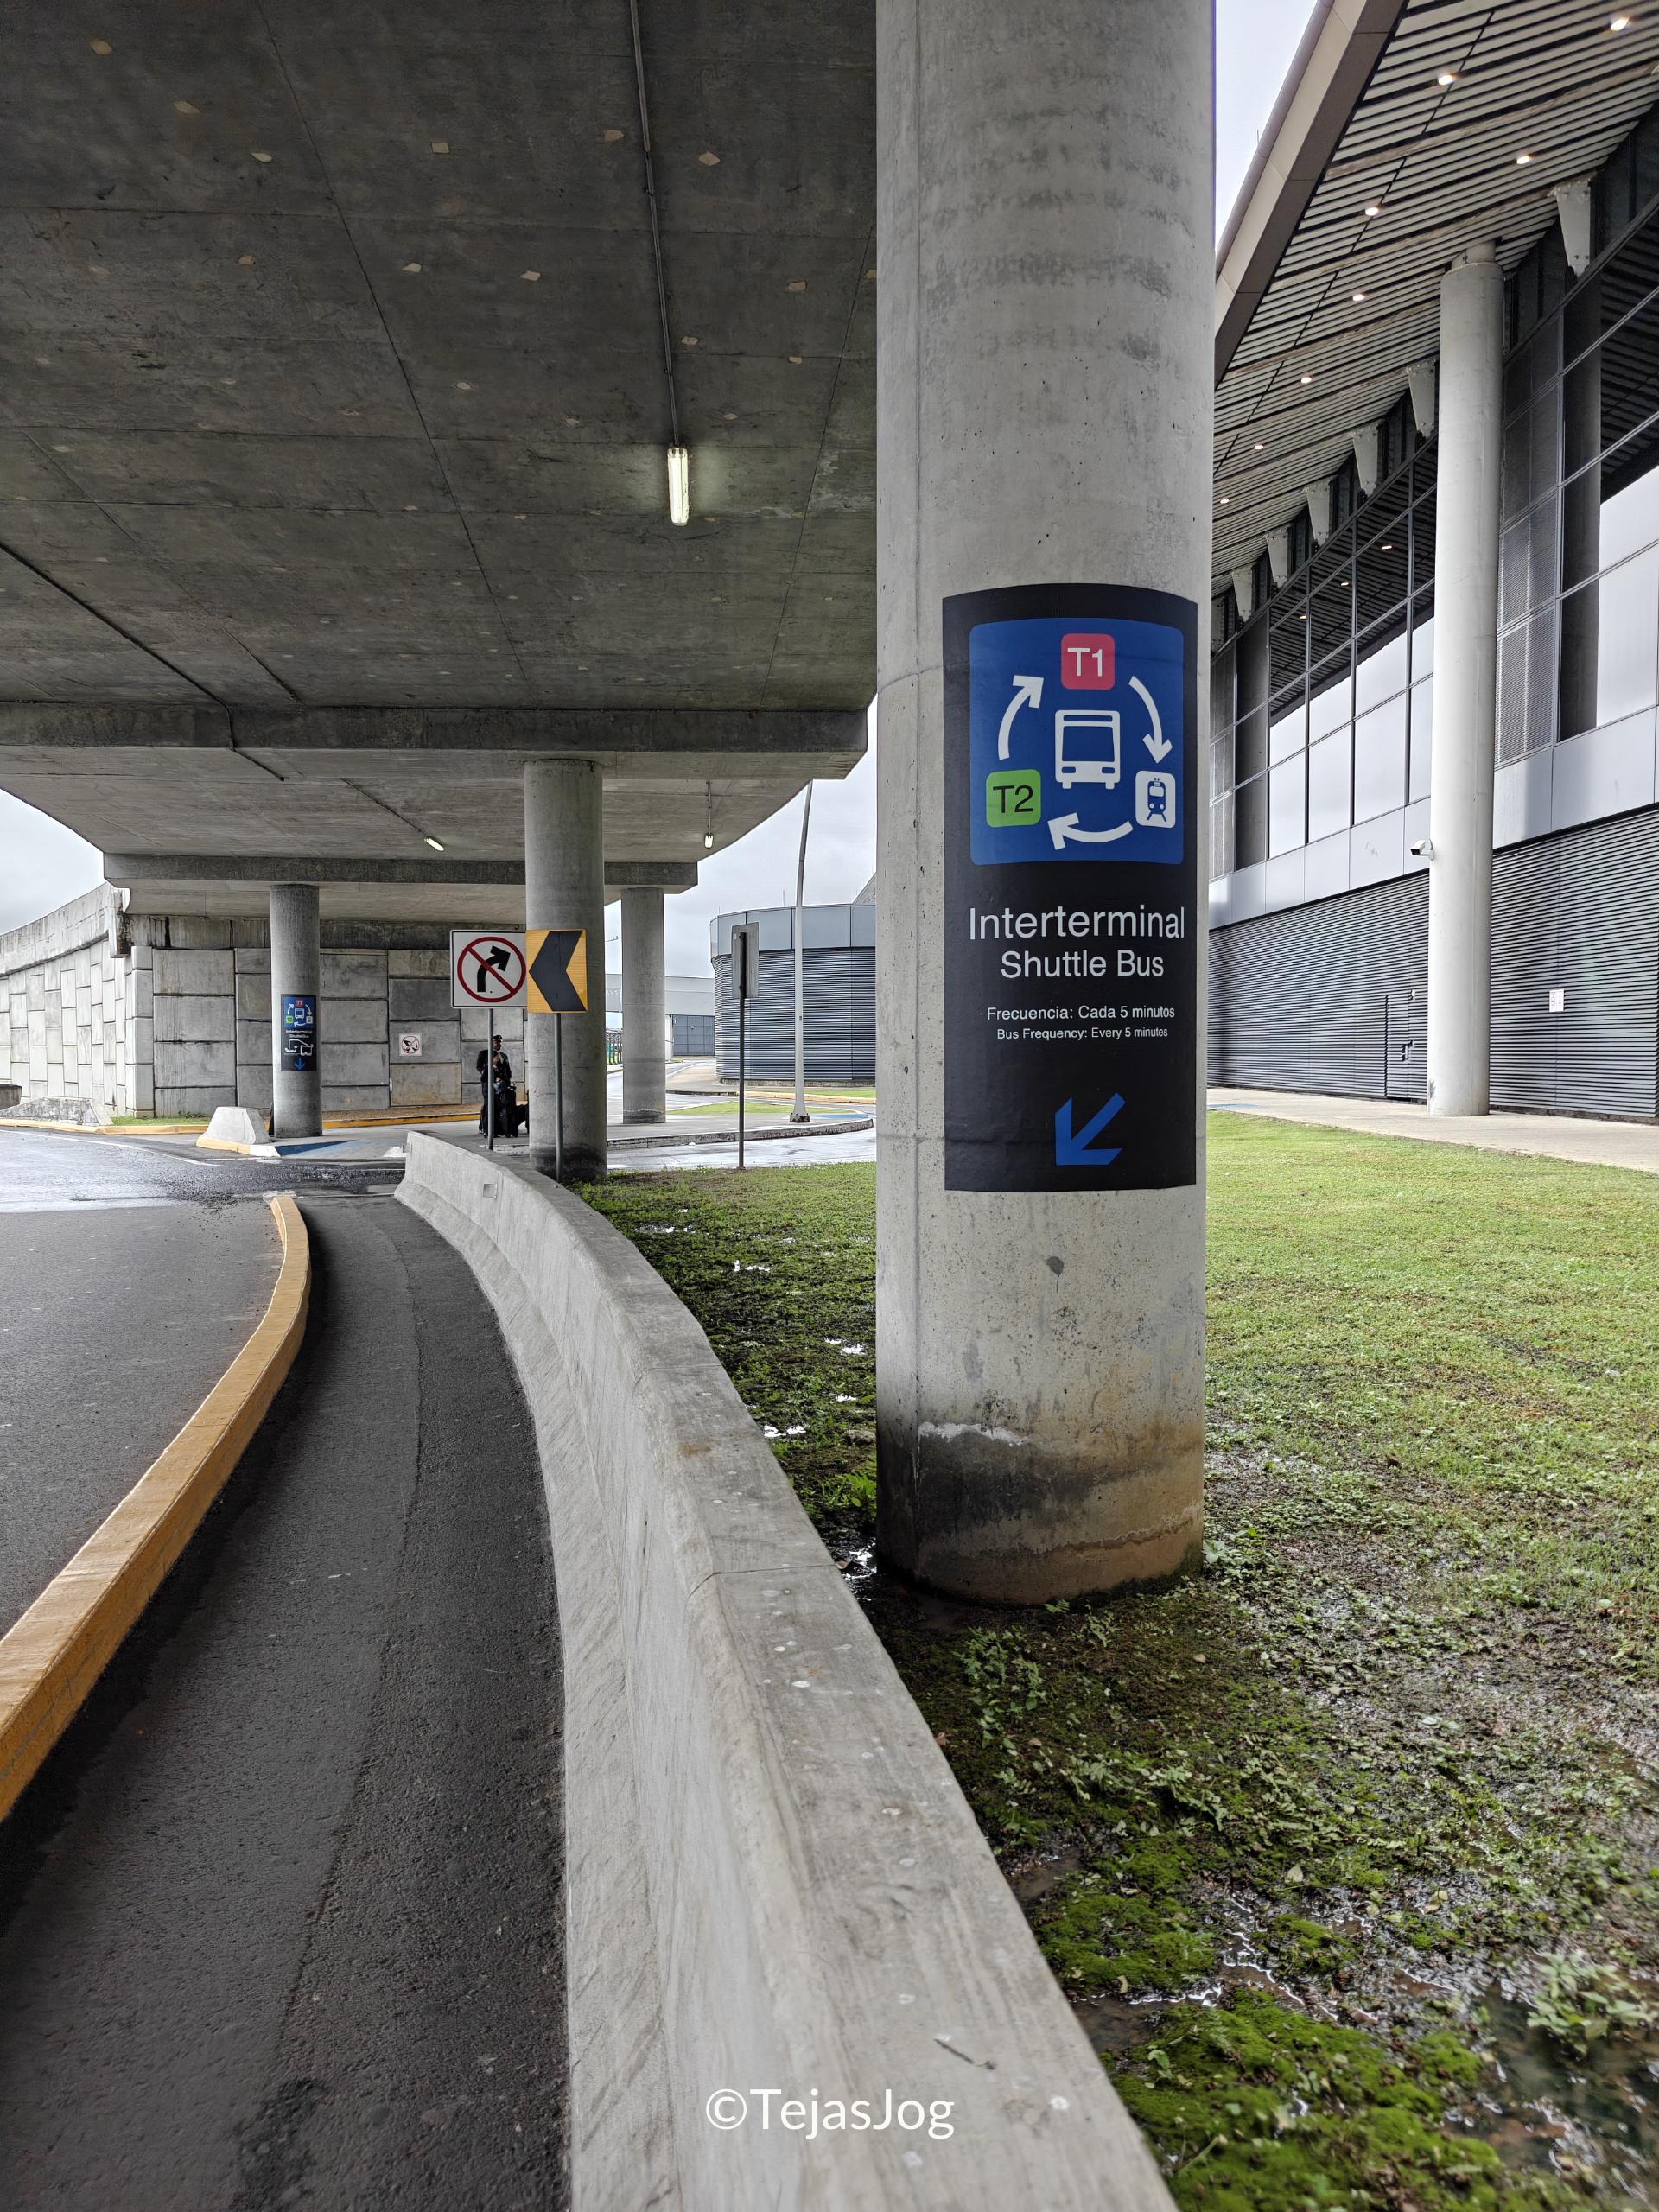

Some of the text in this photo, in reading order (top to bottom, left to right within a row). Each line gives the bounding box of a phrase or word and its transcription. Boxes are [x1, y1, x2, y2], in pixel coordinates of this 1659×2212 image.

[1067, 647, 1103, 677] T1
[992, 785, 1033, 814] T2
[969, 904, 1185, 940] Interterminal
[1001, 950, 1164, 979] Shuttle Bus
[986, 1005, 1175, 1020] Frecuencia: Cada 5 minutos
[996, 1027, 1168, 1041] Bus Frequency: Every 5 minutes
